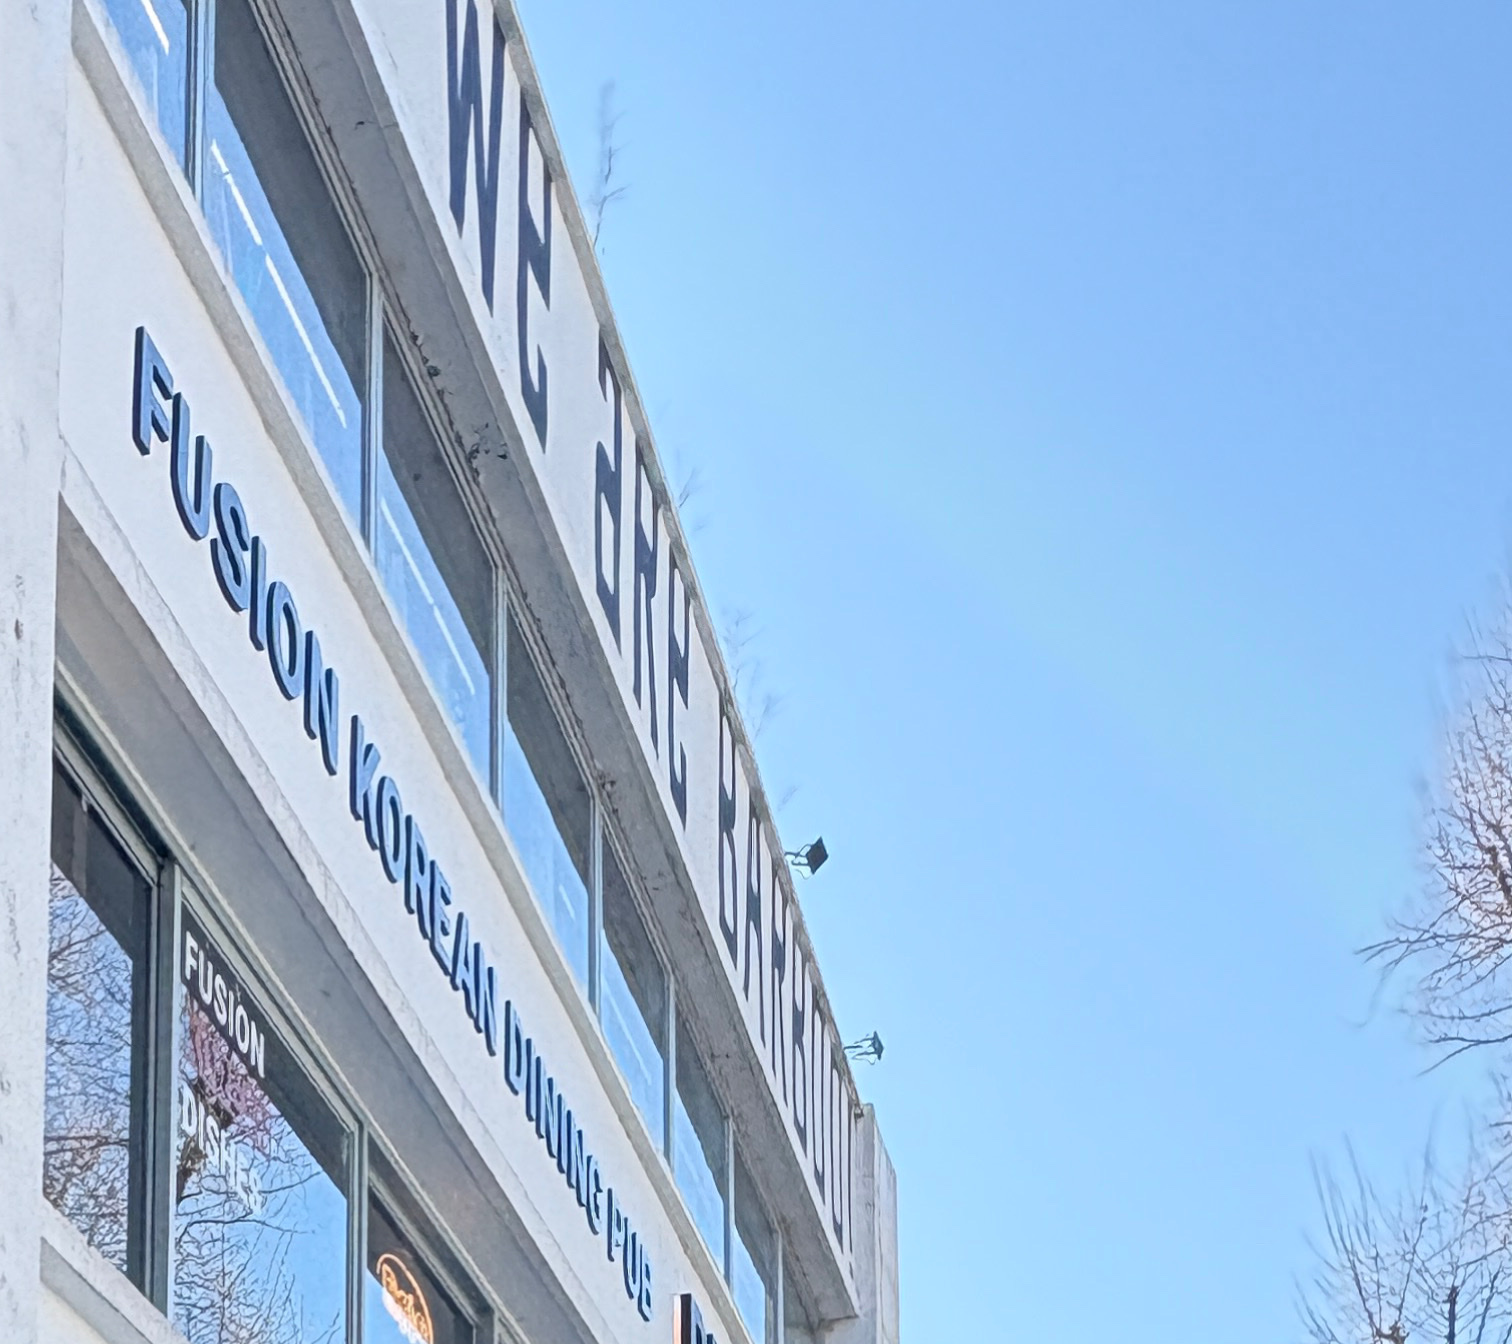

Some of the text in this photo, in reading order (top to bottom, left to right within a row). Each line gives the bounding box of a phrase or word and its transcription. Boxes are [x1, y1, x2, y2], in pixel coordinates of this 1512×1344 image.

[131, 325, 340, 777] FUSION
[349, 714, 498, 1057] KOREAN
[504, 1000, 603, 1236] DINING
[607, 1187, 655, 1323] PUB
[184, 930, 266, 1079] FUSION
